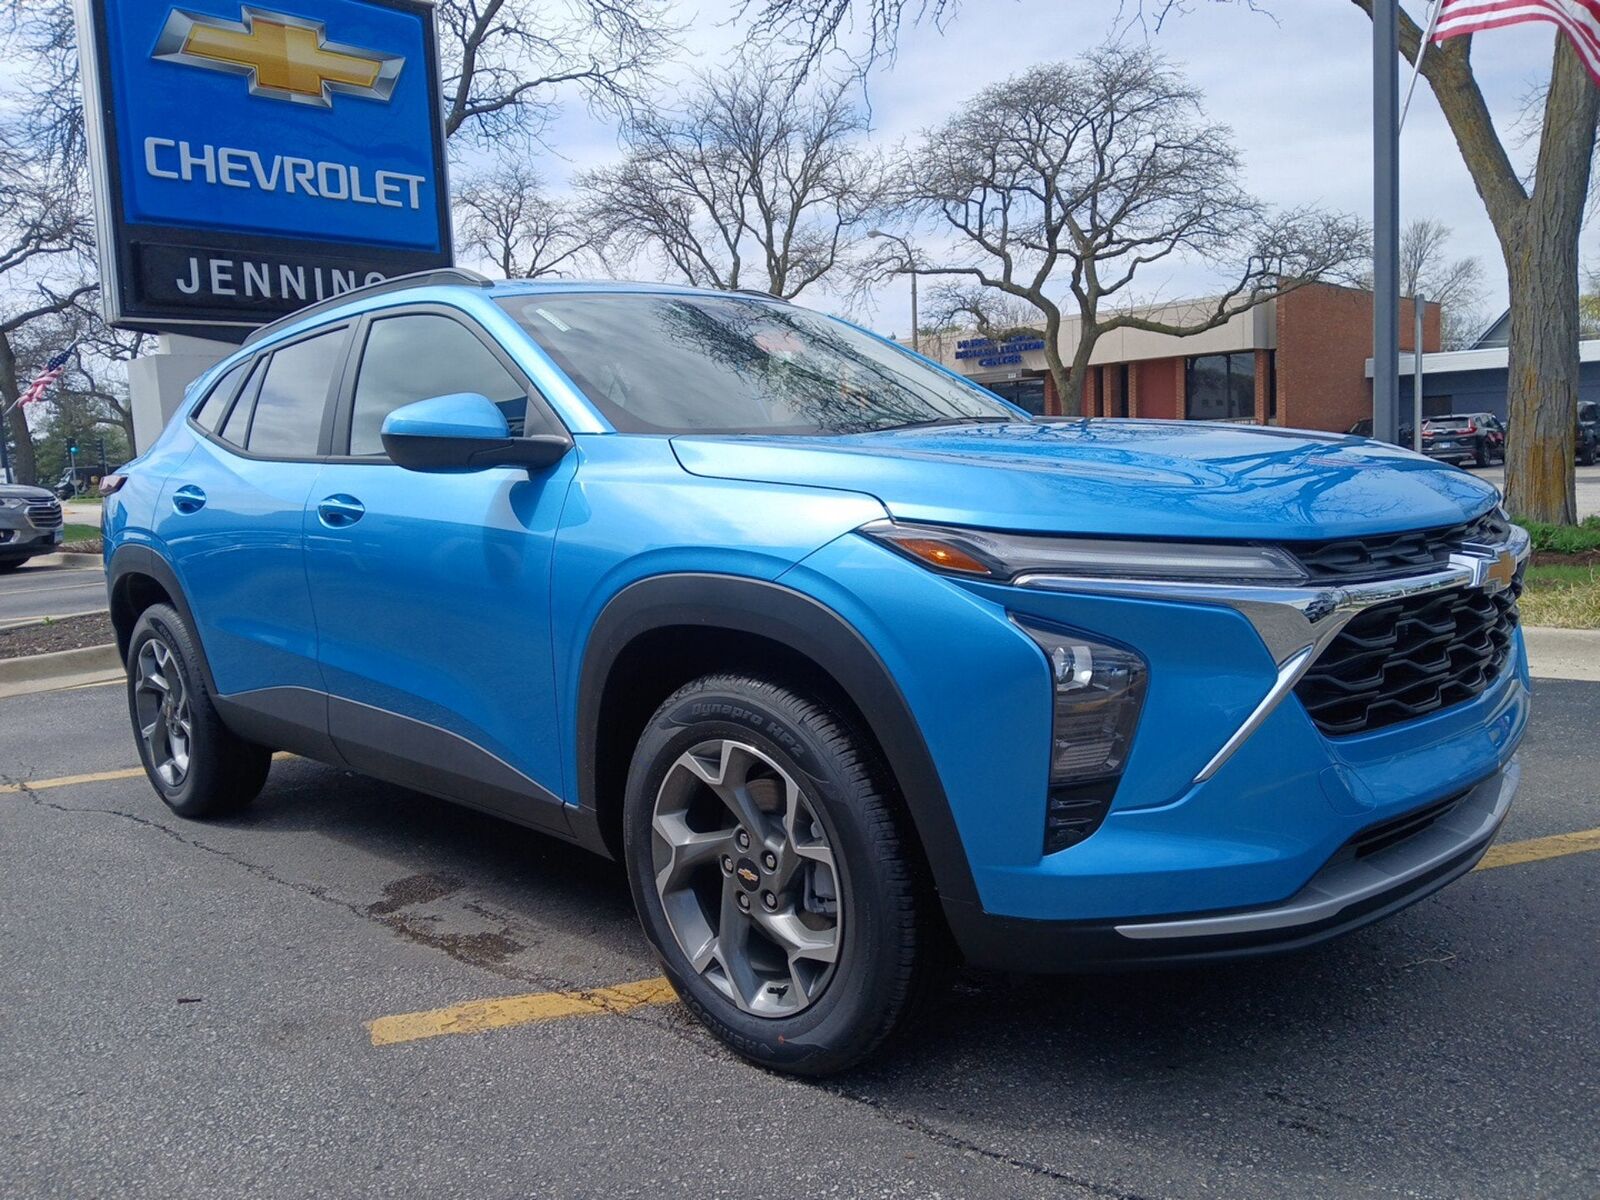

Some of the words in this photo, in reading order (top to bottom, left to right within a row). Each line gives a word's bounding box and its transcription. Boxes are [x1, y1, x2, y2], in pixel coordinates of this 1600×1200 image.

[144, 136, 426, 210] CHEVROLET
[692, 703, 763, 726] Dynapro
[766, 721, 805, 758] HP2
